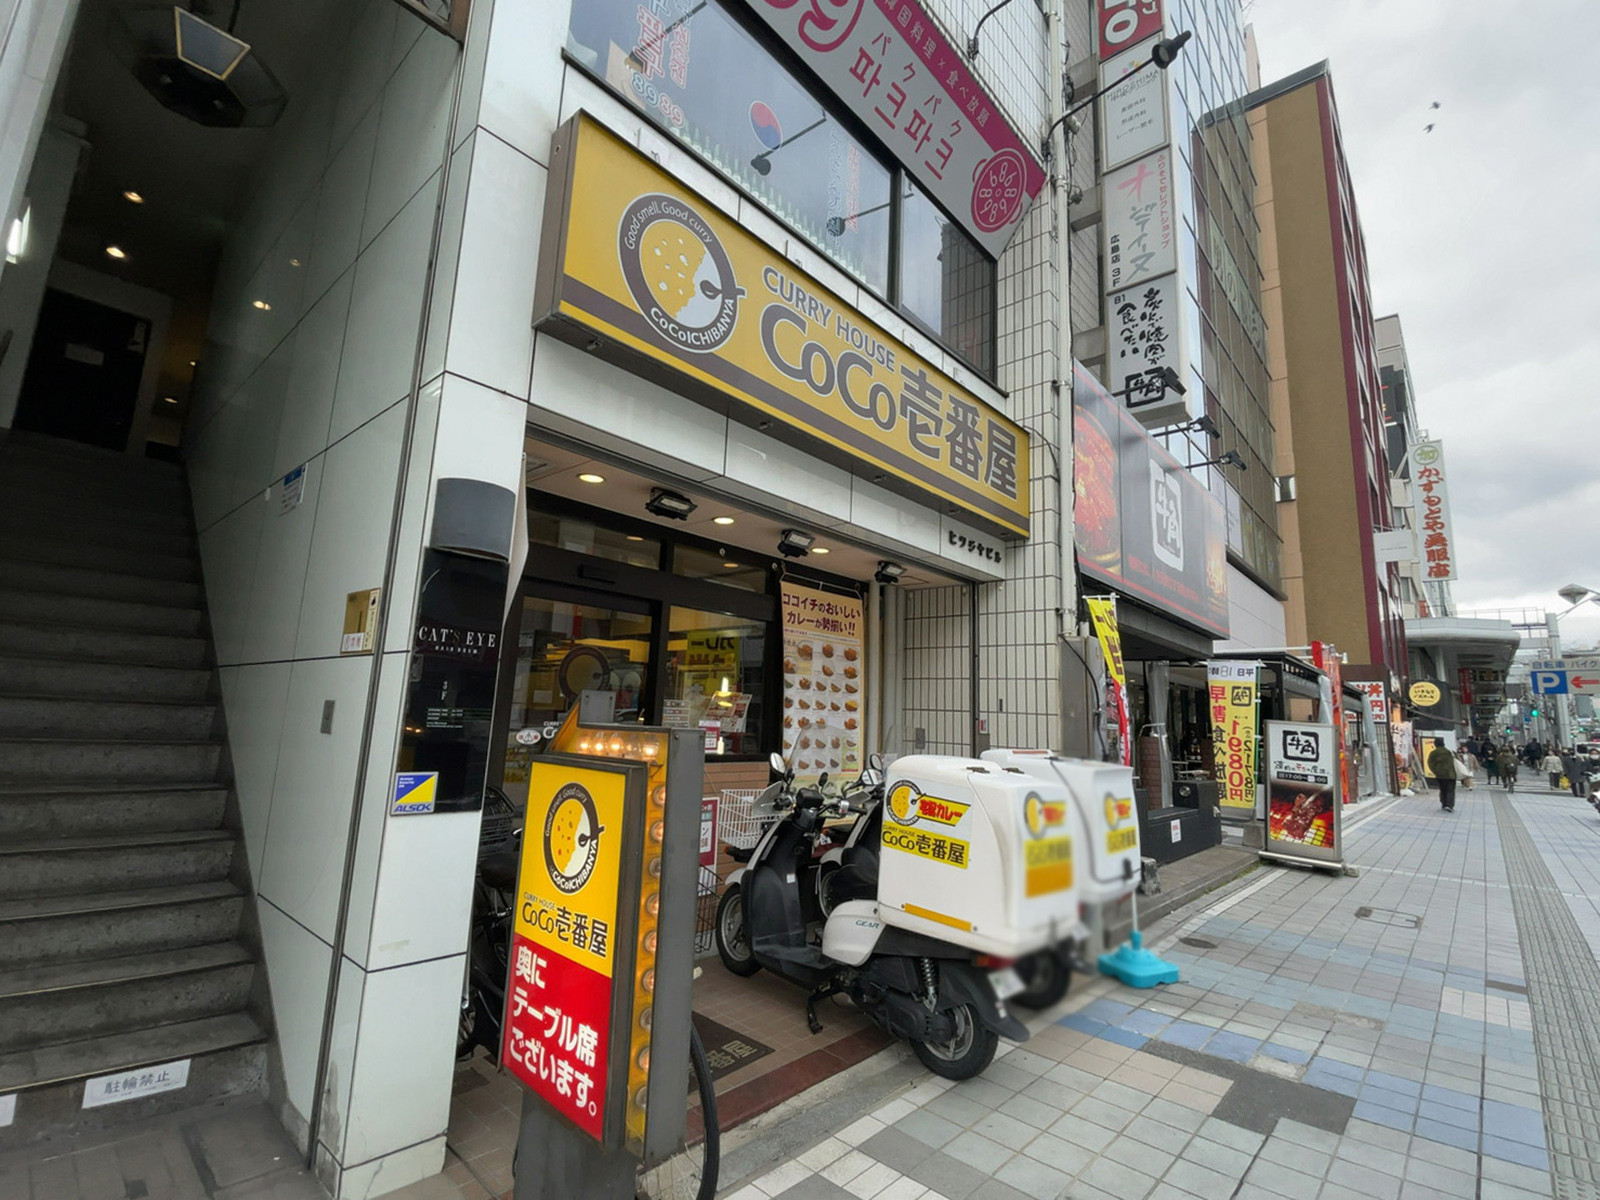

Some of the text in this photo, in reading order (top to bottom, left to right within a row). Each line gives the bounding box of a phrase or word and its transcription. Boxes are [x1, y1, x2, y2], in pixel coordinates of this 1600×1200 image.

[624, 215, 641, 250] Good
[661, 201, 689, 221] Good
[688, 217, 713, 244] curry
[762, 265, 896, 373] CURRY HOUSE
[760, 303, 1017, 500] CoCo壱番屋
[782, 593, 861, 619] ココイチのおいしい
[418, 625, 497, 648] CAT'S EYE
[1537, 673, 1560, 694] P
[1286, 733, 1317, 758] 牛角
[394, 803, 433, 813] ALSOK
[882, 830, 965, 866] CoCo壱番屋
[522, 901, 608, 958] CoCo壱番屋
[855, 919, 880, 929] GEAR
[515, 945, 548, 990] 奥に
[513, 986, 599, 1068] テーブル席
[104, 1070, 171, 1095] 駐輪禁止
[510, 1026, 597, 1118] ございます。
